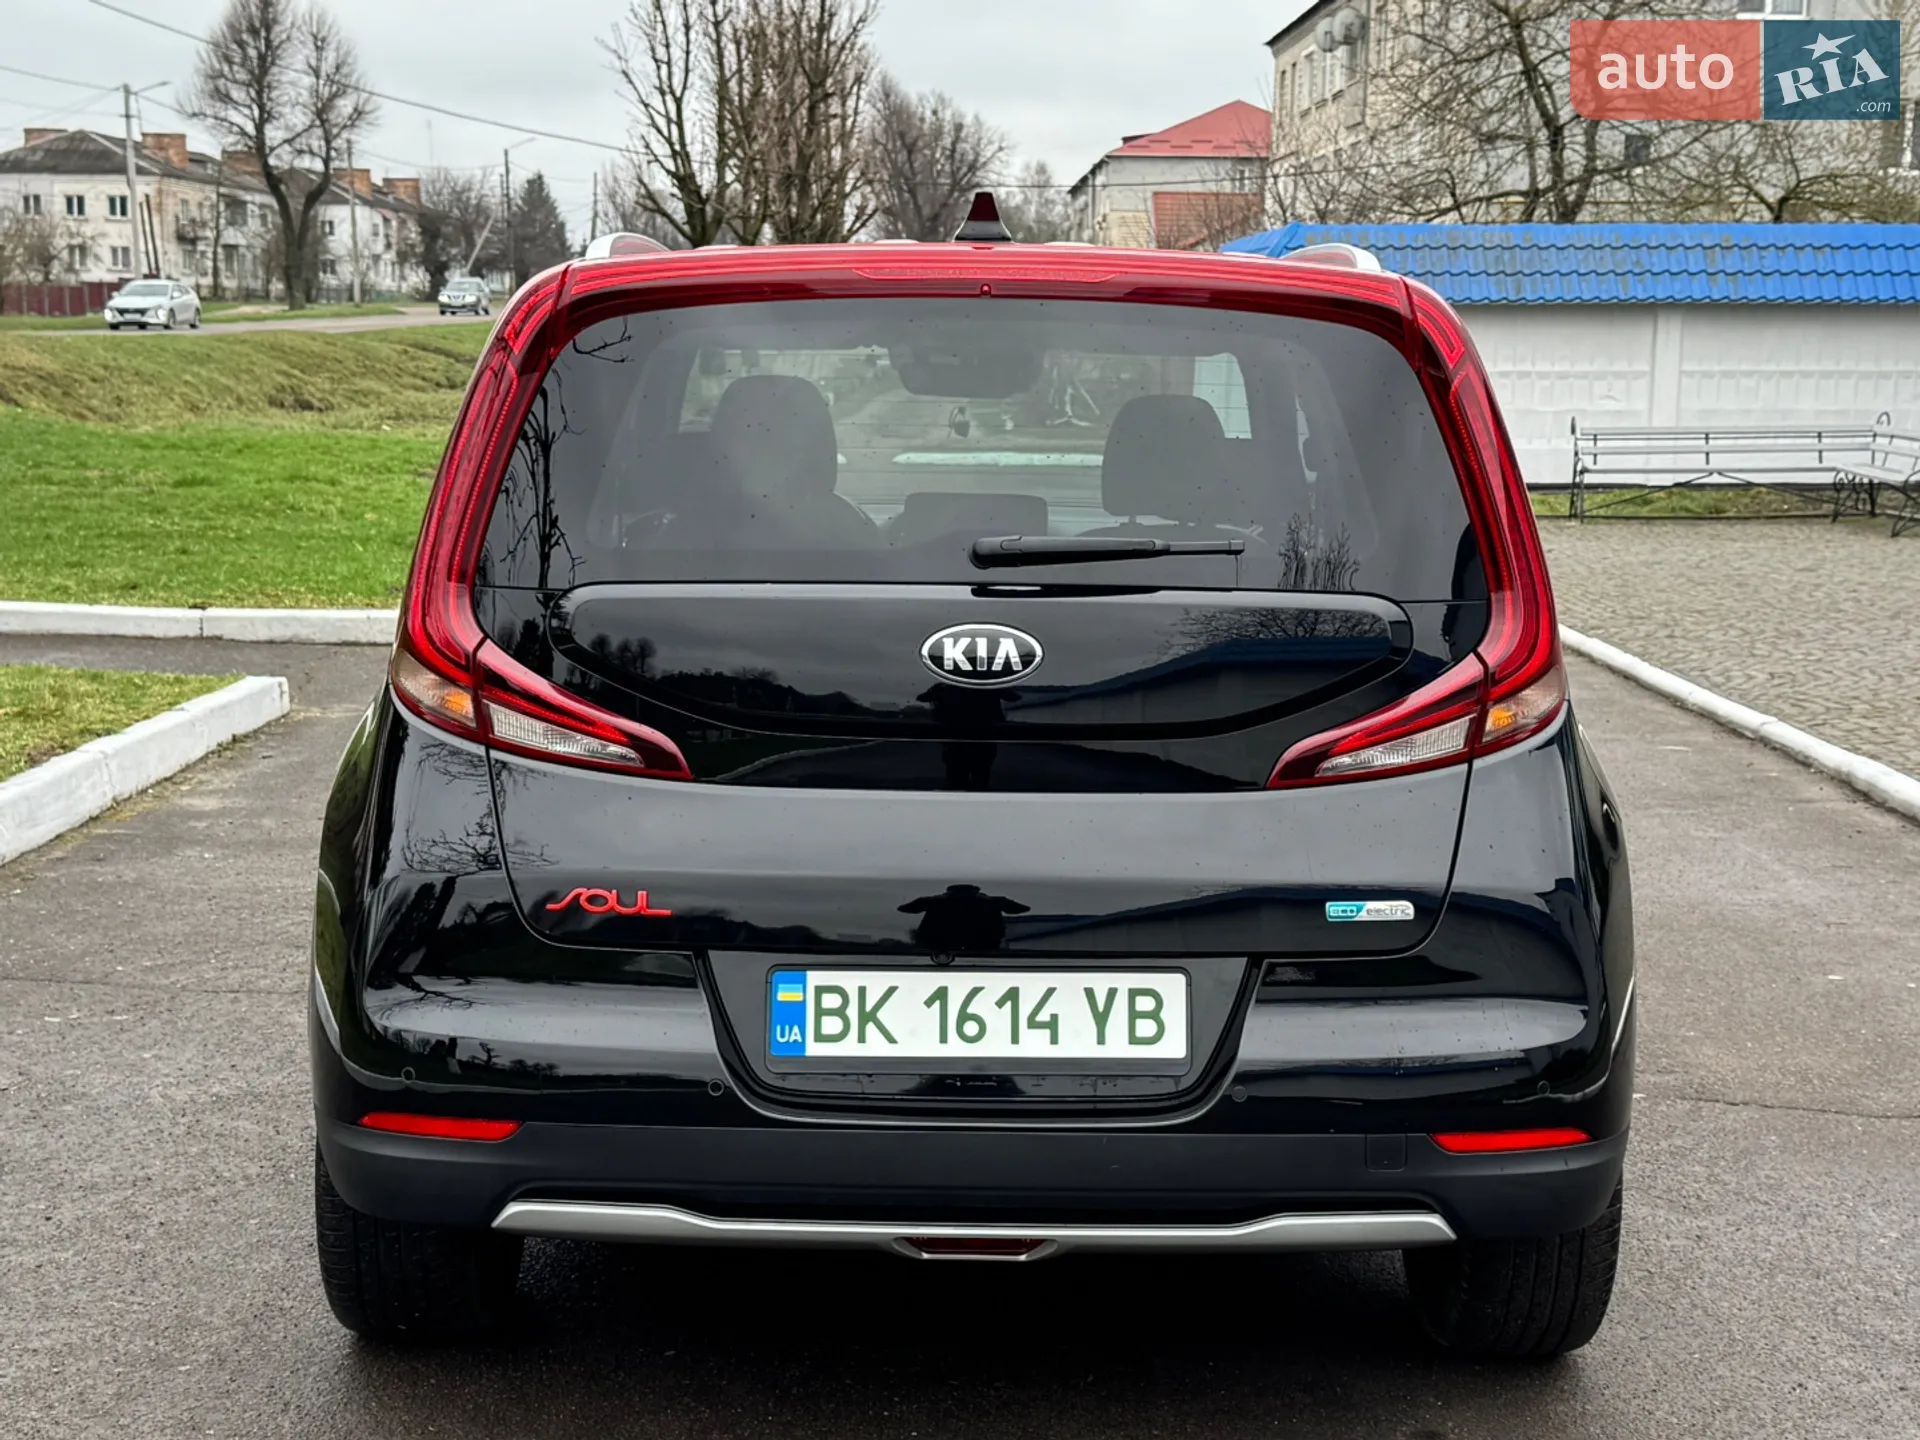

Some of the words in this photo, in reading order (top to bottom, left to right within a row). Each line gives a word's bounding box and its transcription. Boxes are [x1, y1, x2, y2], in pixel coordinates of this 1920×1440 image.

[942, 637, 1023, 671] KIA
[1366, 904, 1411, 917] electric
[813, 985, 899, 1045] BK
[923, 985, 1060, 1045] 1614
[1083, 986, 1166, 1046] YB
[776, 1024, 802, 1043] UA
